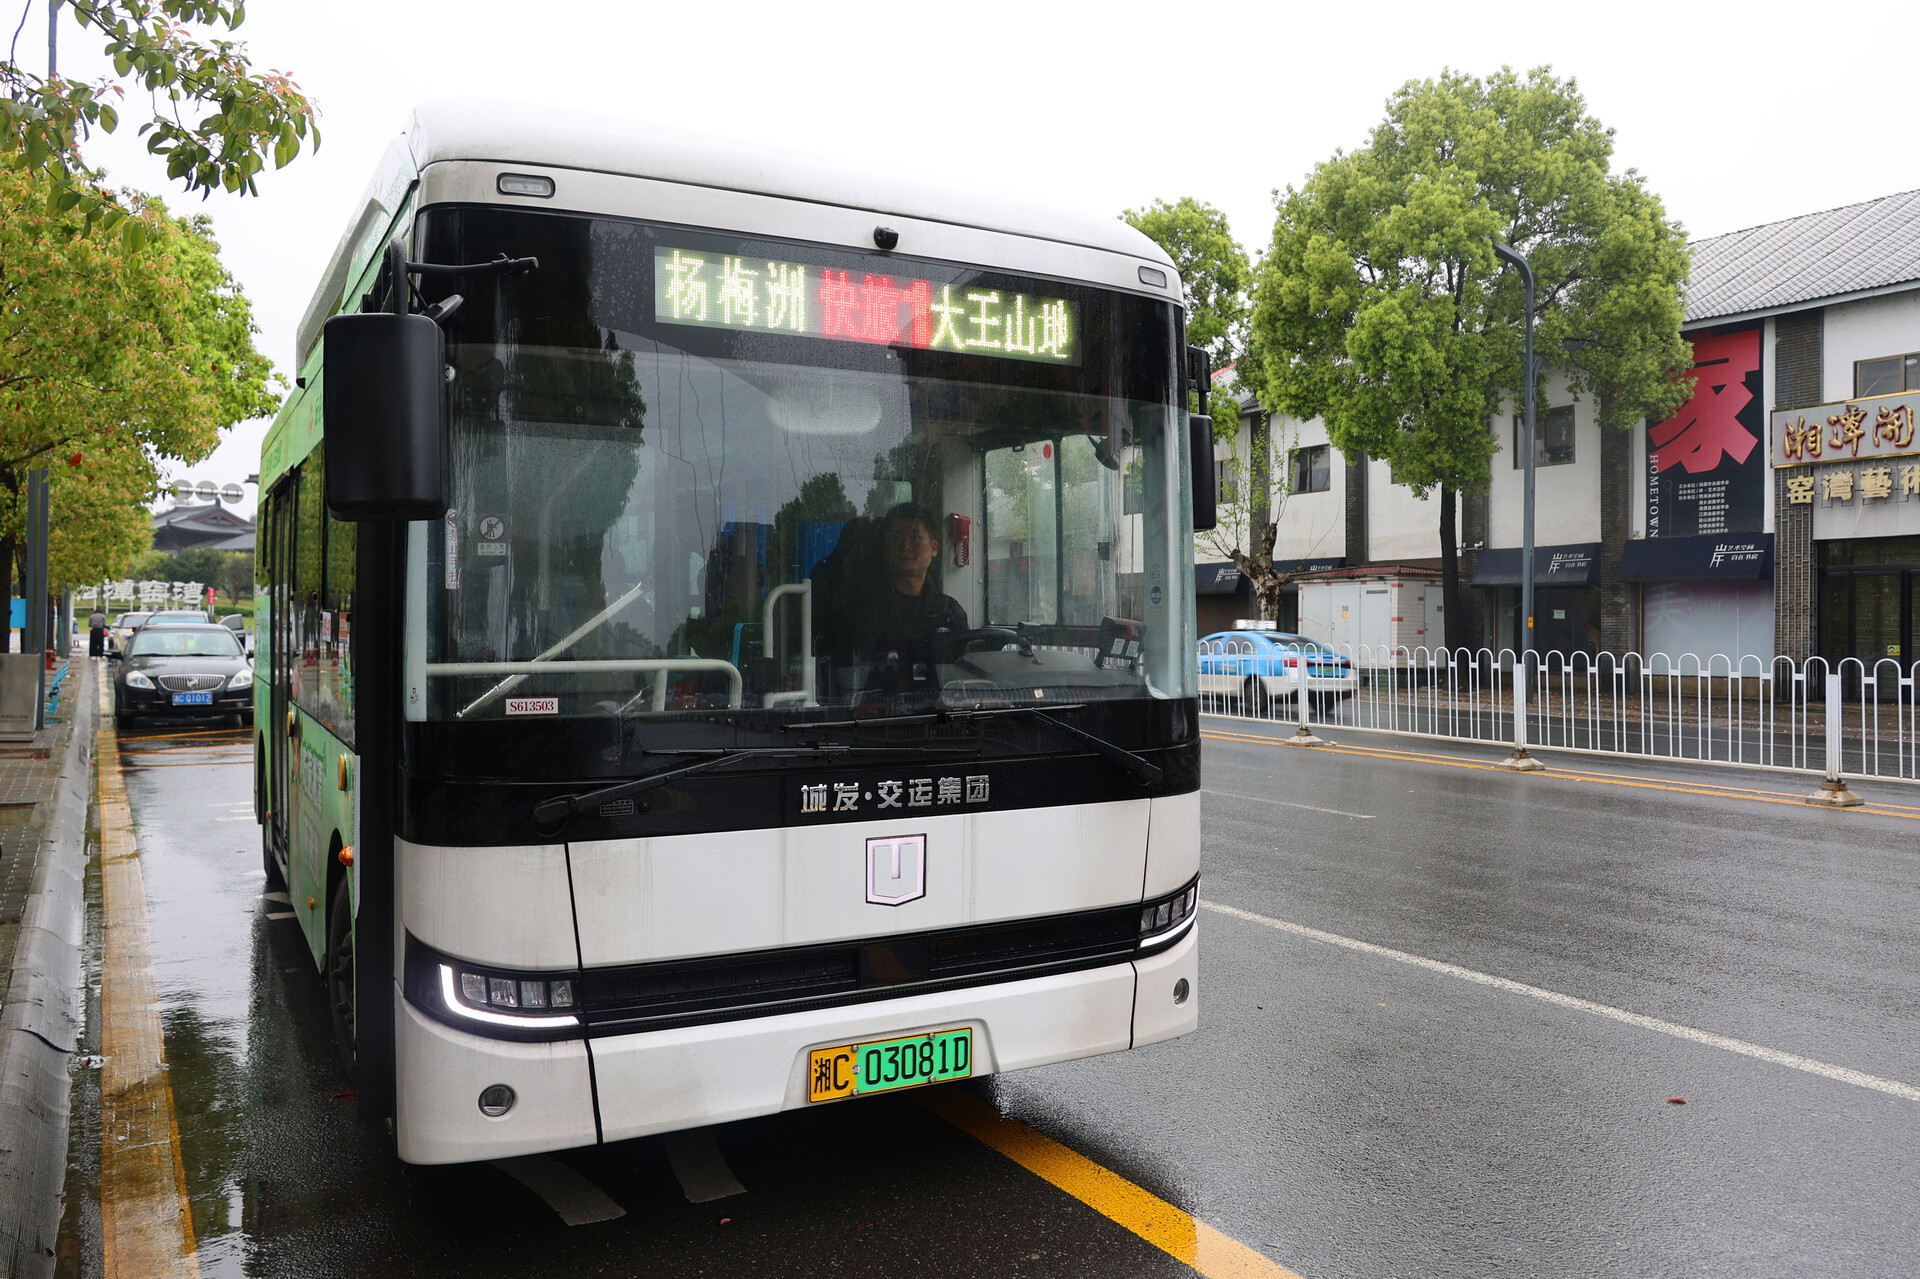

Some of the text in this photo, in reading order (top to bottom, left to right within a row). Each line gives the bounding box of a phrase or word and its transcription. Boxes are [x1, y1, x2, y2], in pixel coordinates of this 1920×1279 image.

[666, 250, 805, 333] 杨梅洲
[1649, 454, 1659, 538] HOMETOWN
[510, 701, 554, 712] S613503
